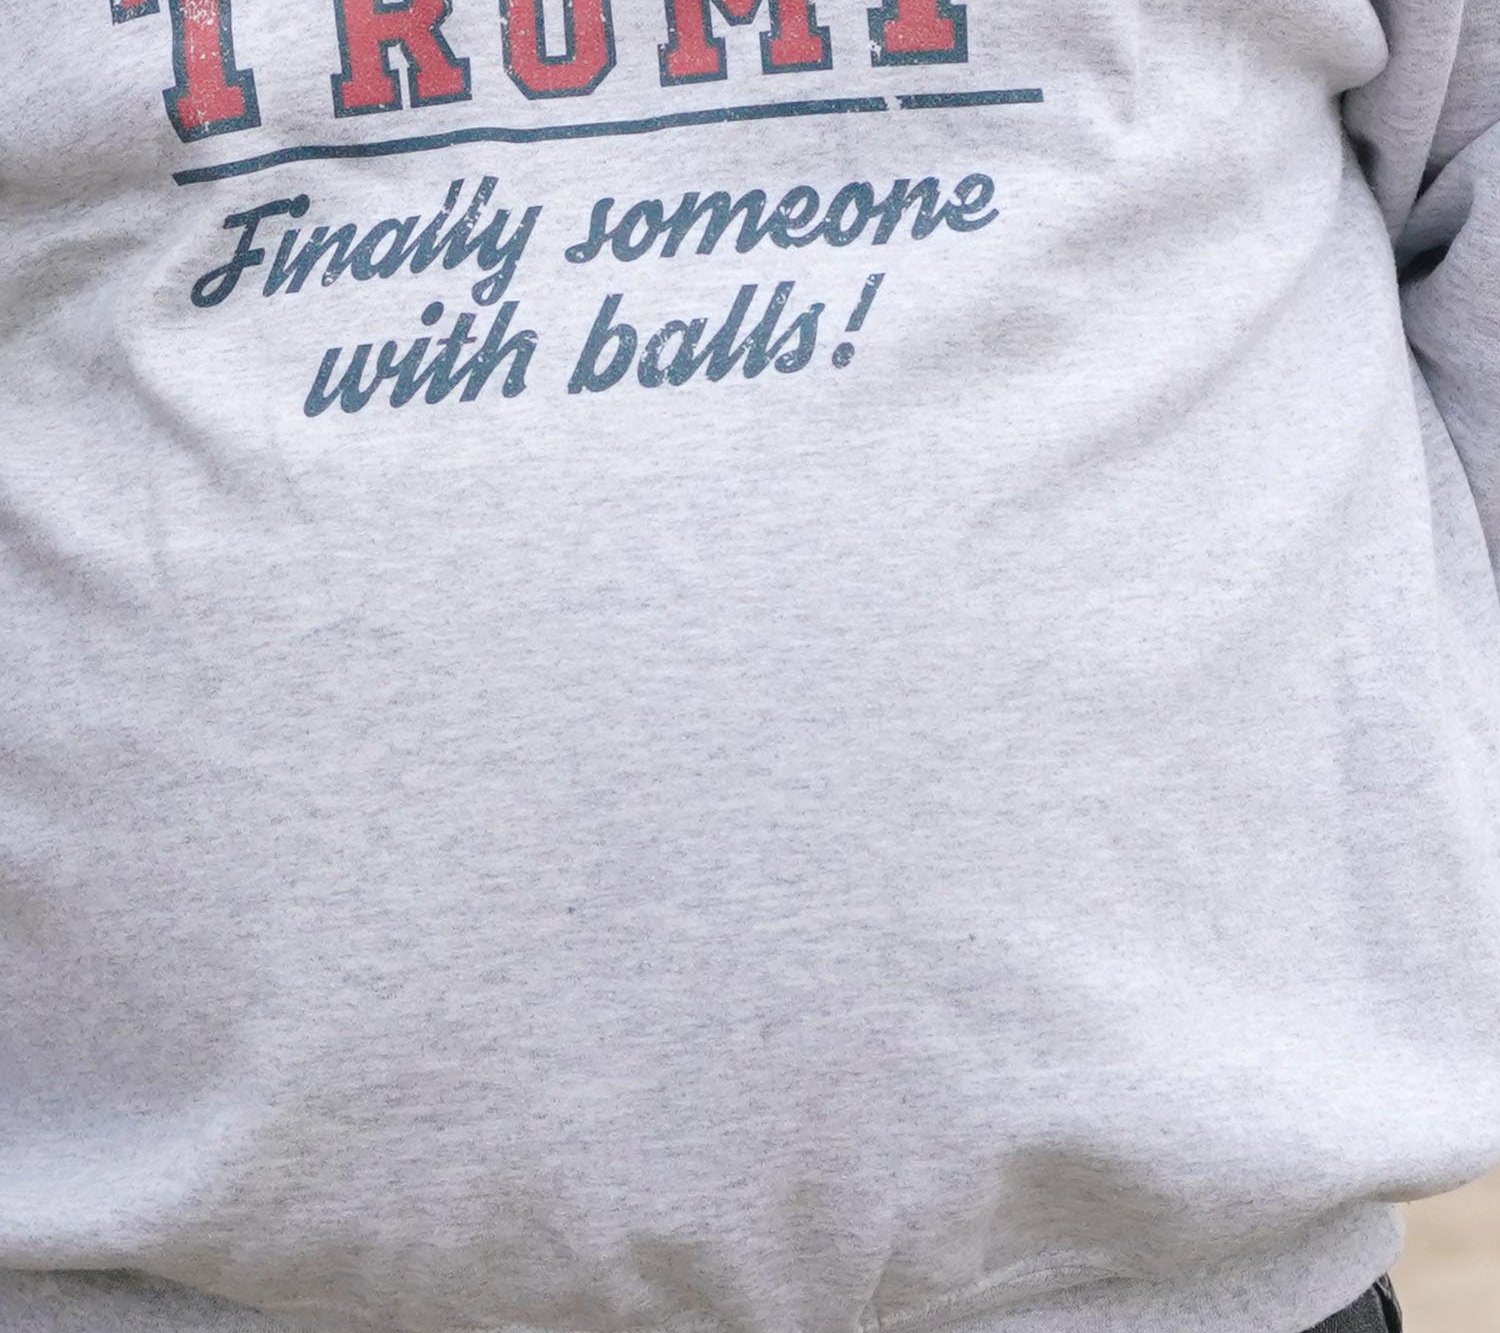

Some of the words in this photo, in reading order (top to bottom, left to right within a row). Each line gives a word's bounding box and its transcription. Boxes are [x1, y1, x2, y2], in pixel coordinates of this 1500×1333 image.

[191, 175, 543, 307] Finally
[565, 172, 999, 265] someone
[302, 299, 538, 418] with
[567, 272, 886, 395] balls!
